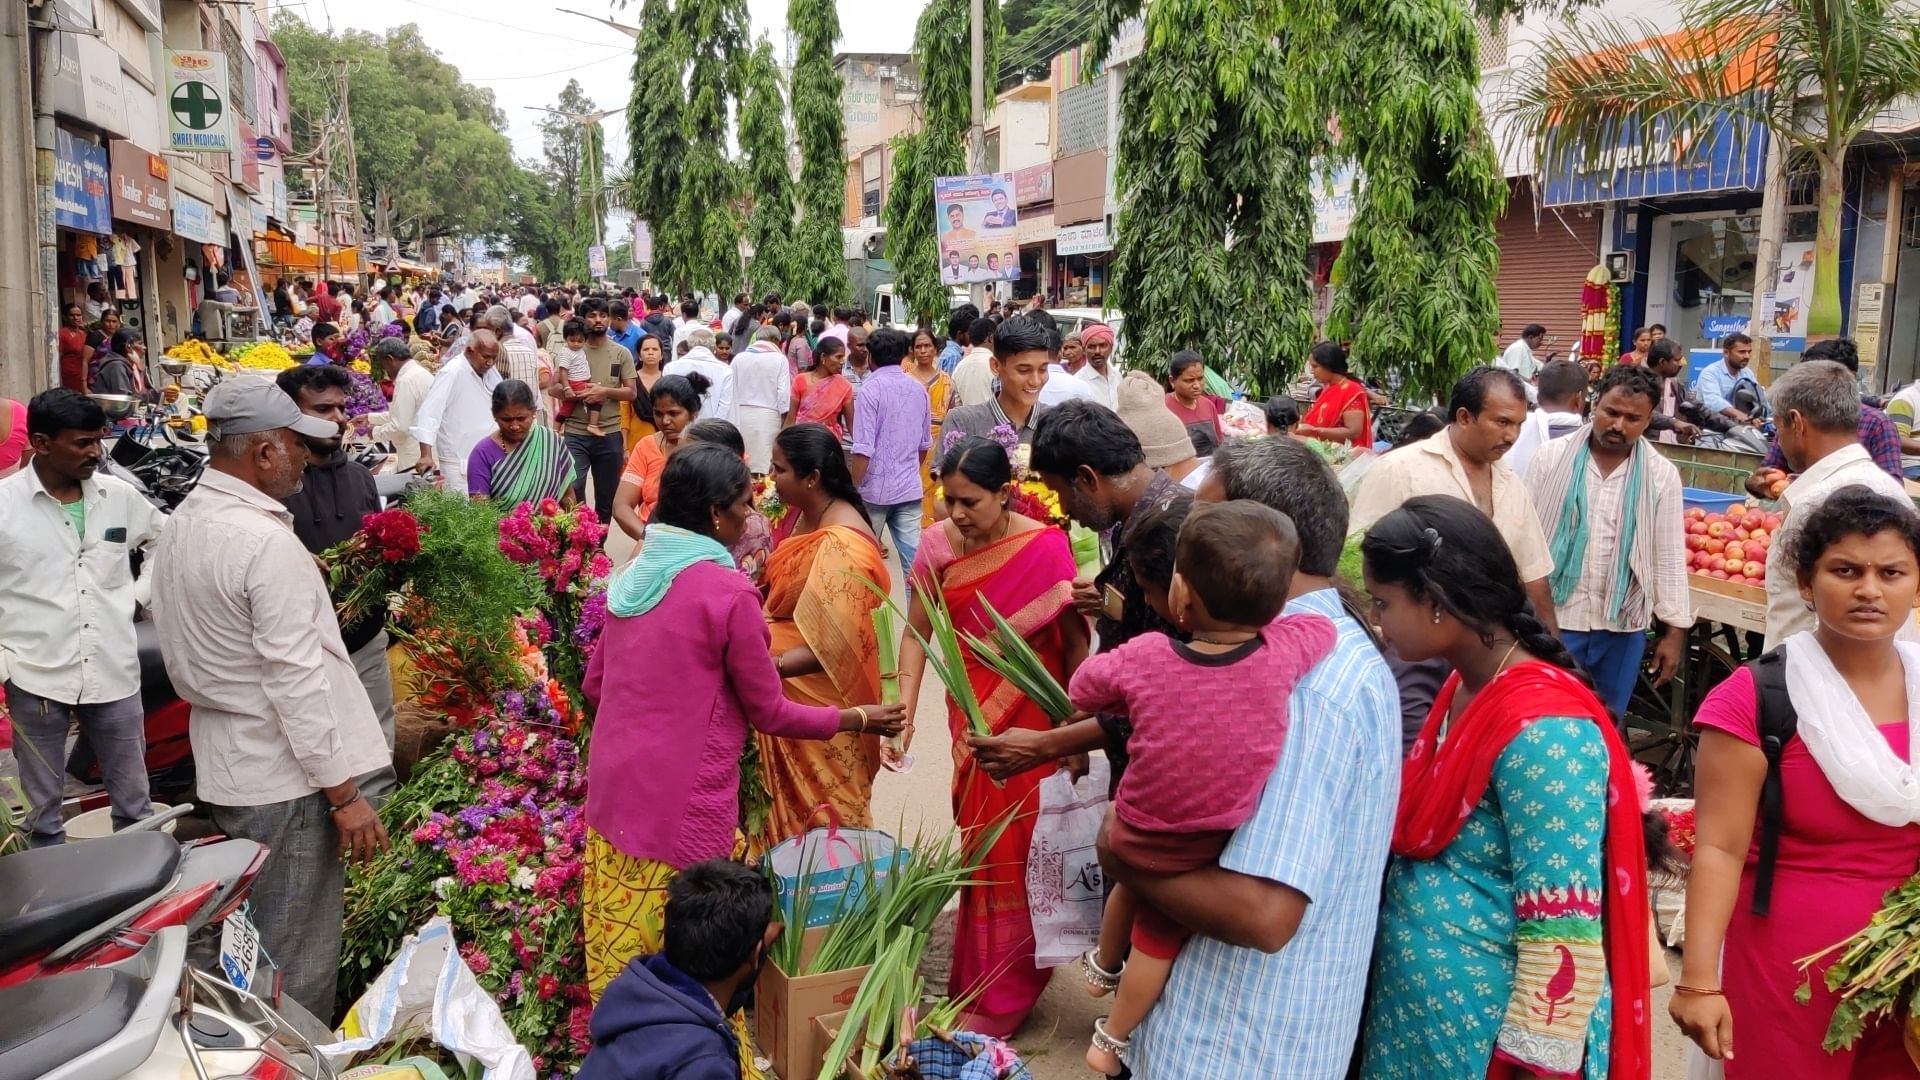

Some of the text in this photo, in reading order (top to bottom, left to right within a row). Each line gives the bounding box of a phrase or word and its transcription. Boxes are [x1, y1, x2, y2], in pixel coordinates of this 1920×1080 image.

[172, 132, 226, 147] SHREE MEDICALS
[1708, 318, 1746, 337] Sangeetha
